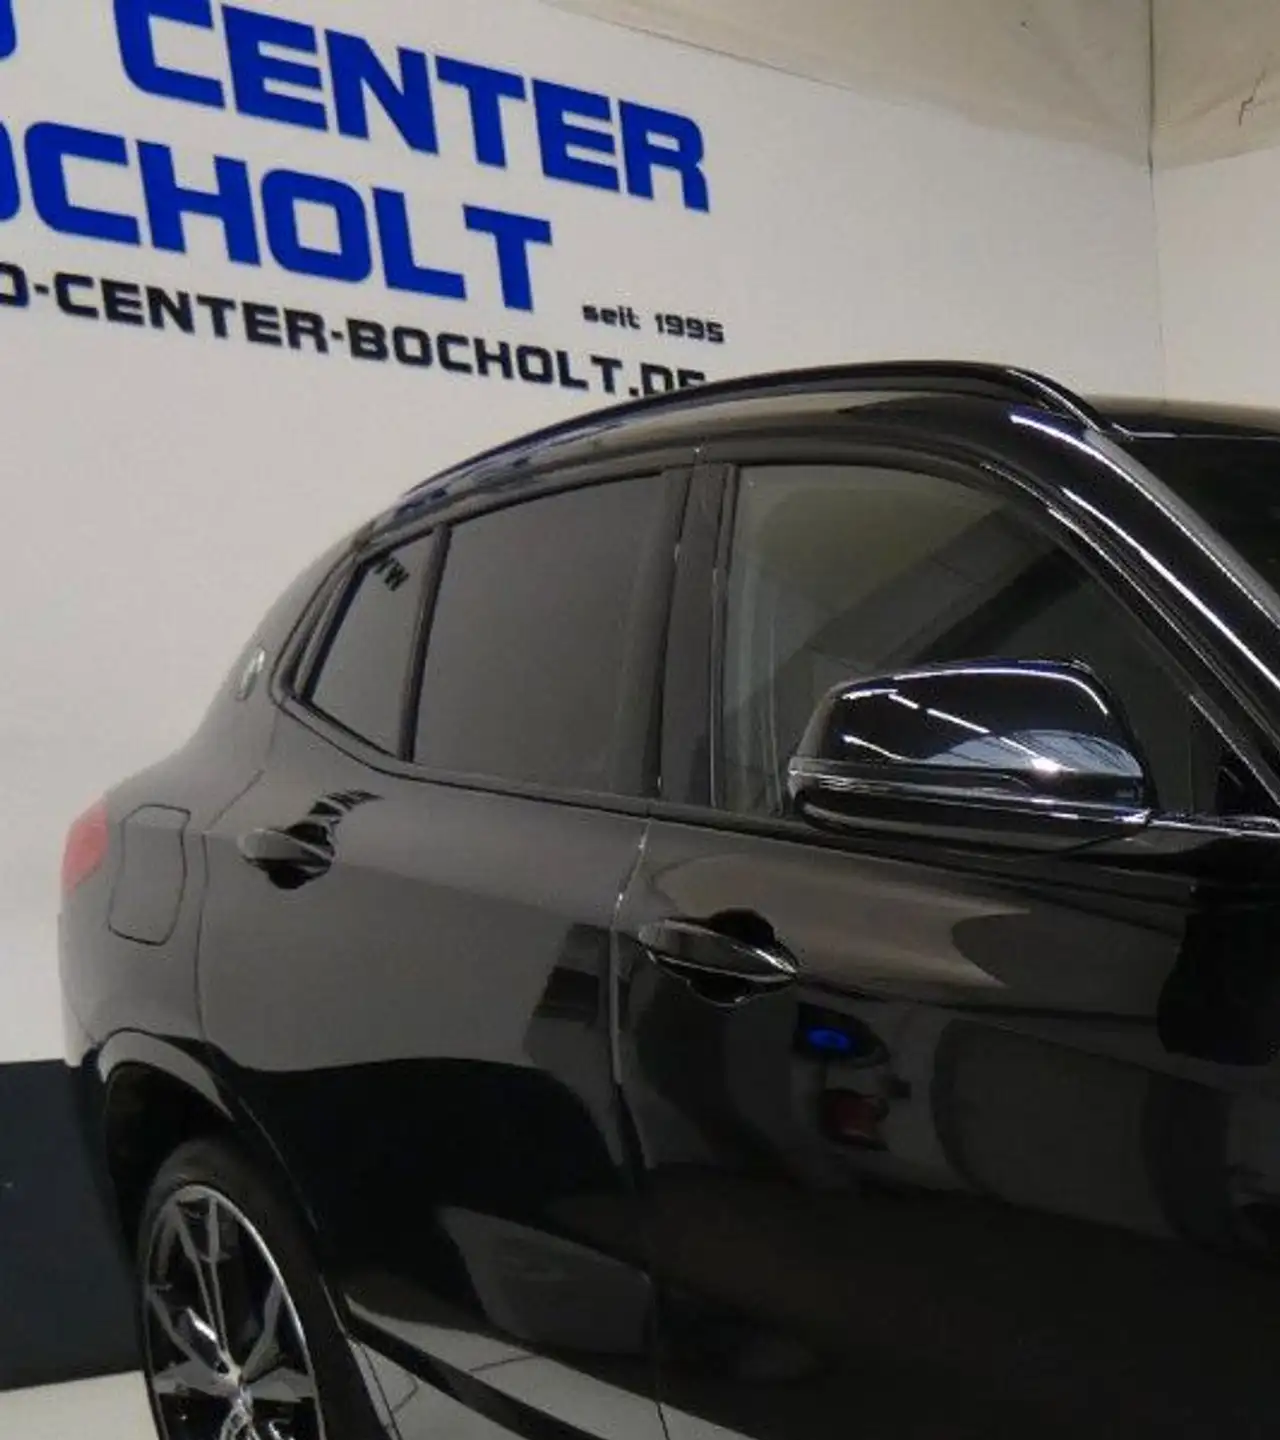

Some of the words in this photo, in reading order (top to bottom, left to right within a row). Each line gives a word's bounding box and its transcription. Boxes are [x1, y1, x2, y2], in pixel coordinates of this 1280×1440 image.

[113, 0, 710, 213] CENTER
[0, 122, 553, 310] CHOLT
[582, 304, 641, 330] seit
[654, 313, 725, 344] 1995
